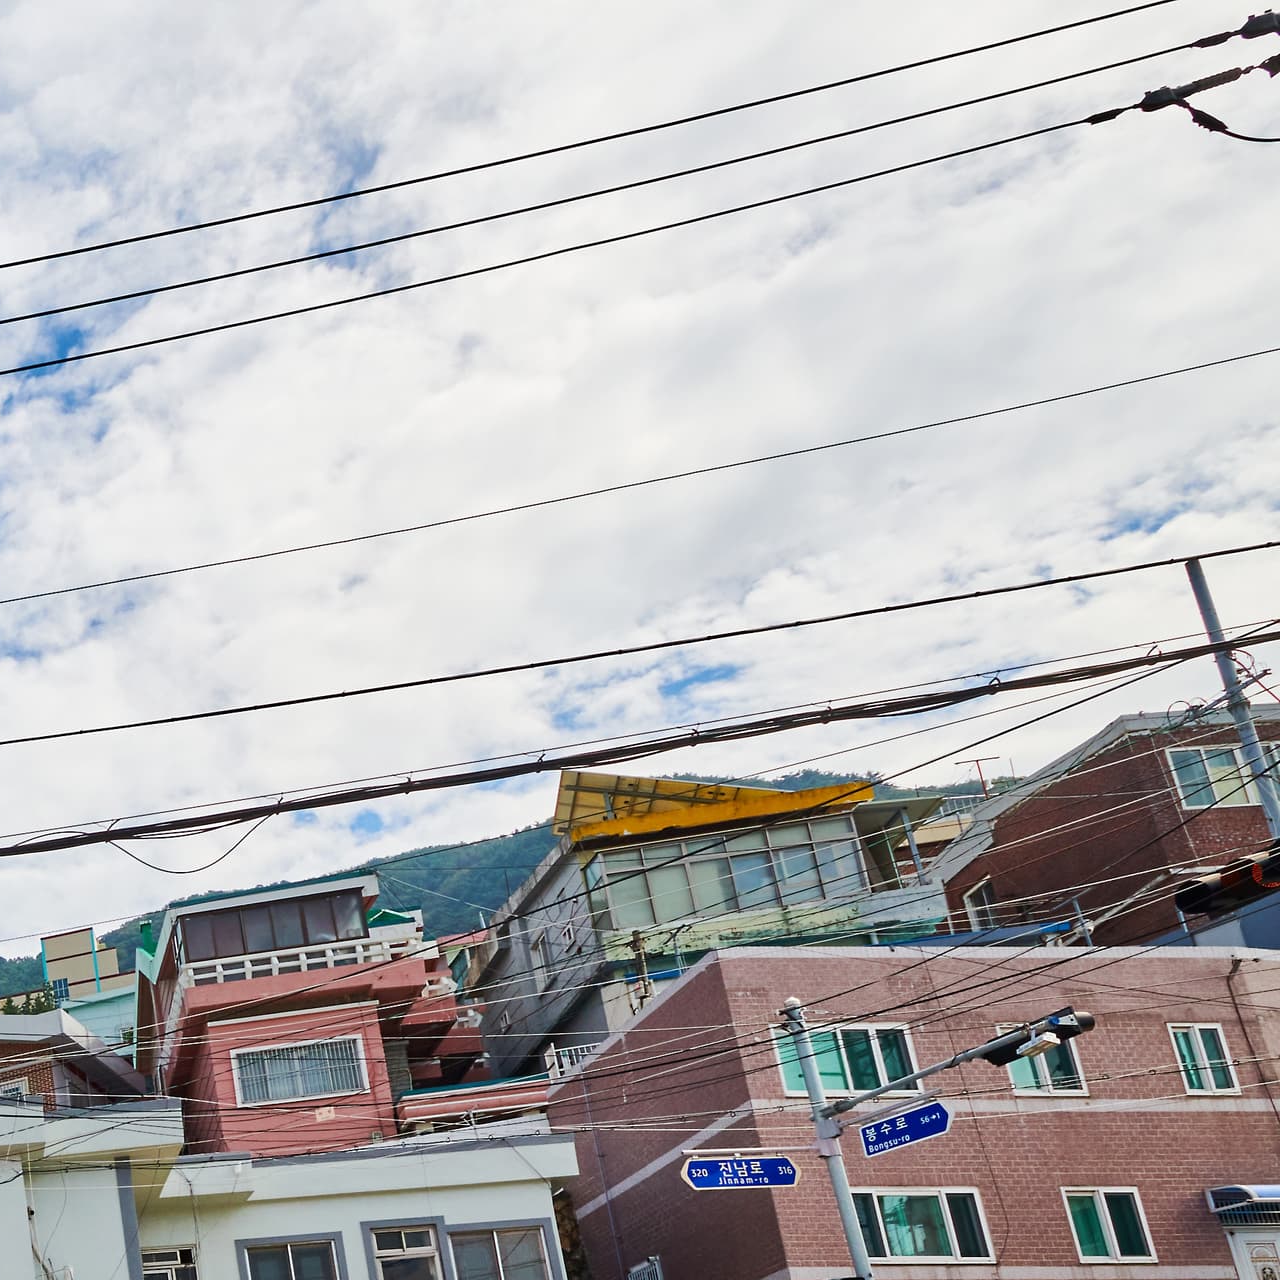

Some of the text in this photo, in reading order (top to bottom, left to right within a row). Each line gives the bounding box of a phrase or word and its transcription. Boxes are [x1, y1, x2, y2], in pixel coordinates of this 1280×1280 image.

[865, 1120, 909, 1143] 봉수로
[868, 1134, 911, 1153] Bongsu-ro
[690, 1168, 708, 1178] 320
[718, 1160, 765, 1177] 진남로
[778, 1165, 793, 1175] 316
[718, 1176, 769, 1186] Jinnam-ro
